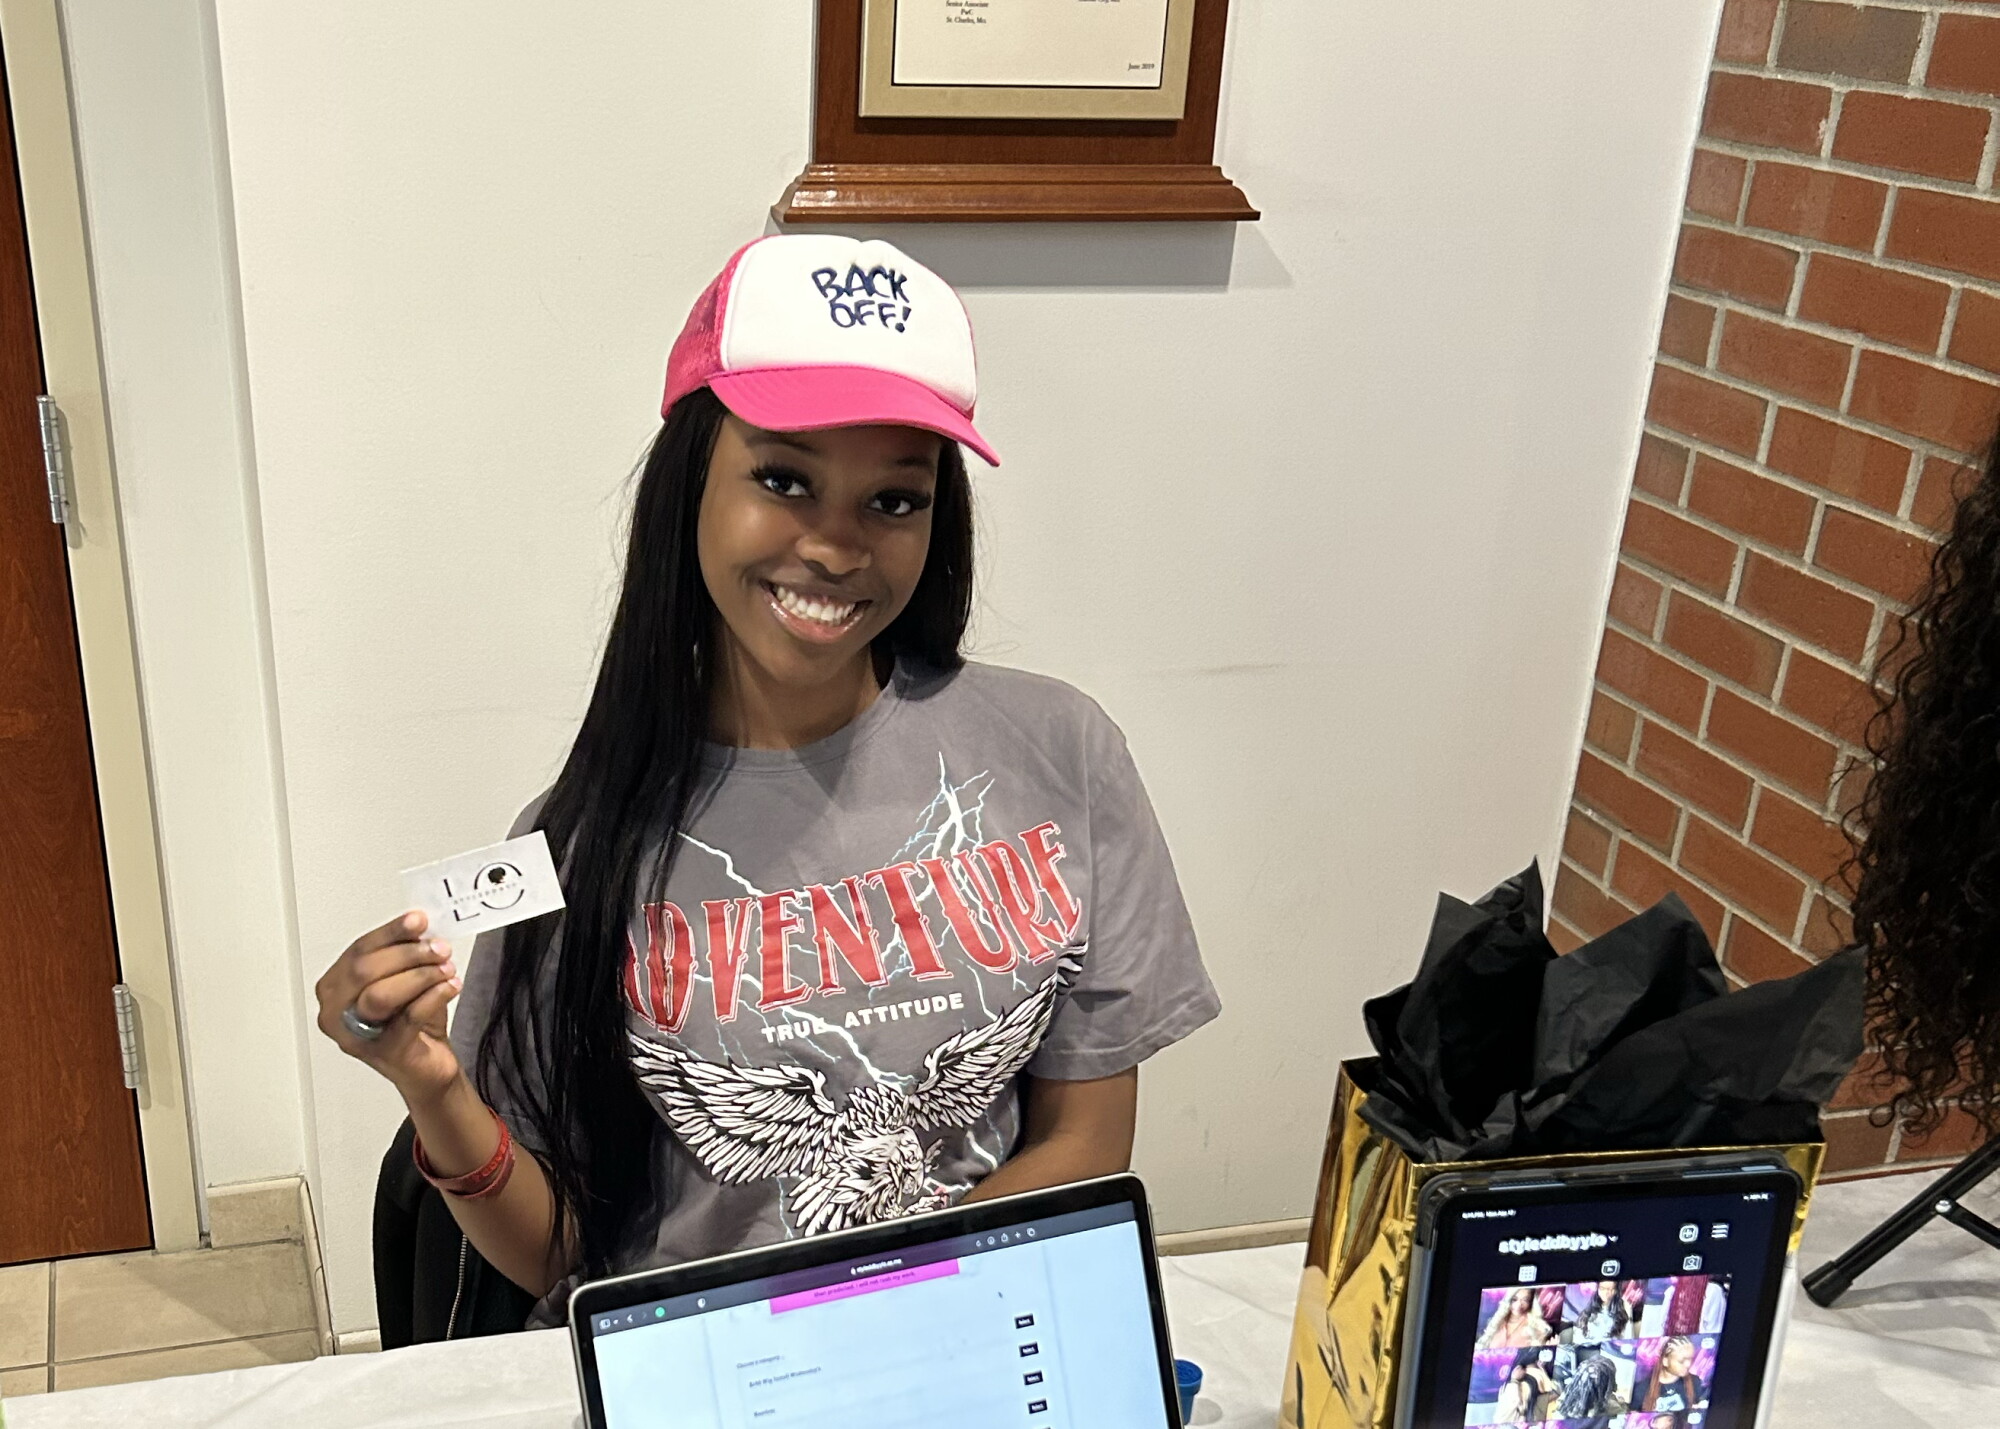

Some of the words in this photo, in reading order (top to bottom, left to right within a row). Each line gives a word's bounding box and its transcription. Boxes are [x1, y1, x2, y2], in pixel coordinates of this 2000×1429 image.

[811, 262, 910, 304] BACK
[829, 299, 912, 333] OFF!
[761, 1016, 828, 1044] TRUE
[844, 993, 965, 1028] ATTITUDE
